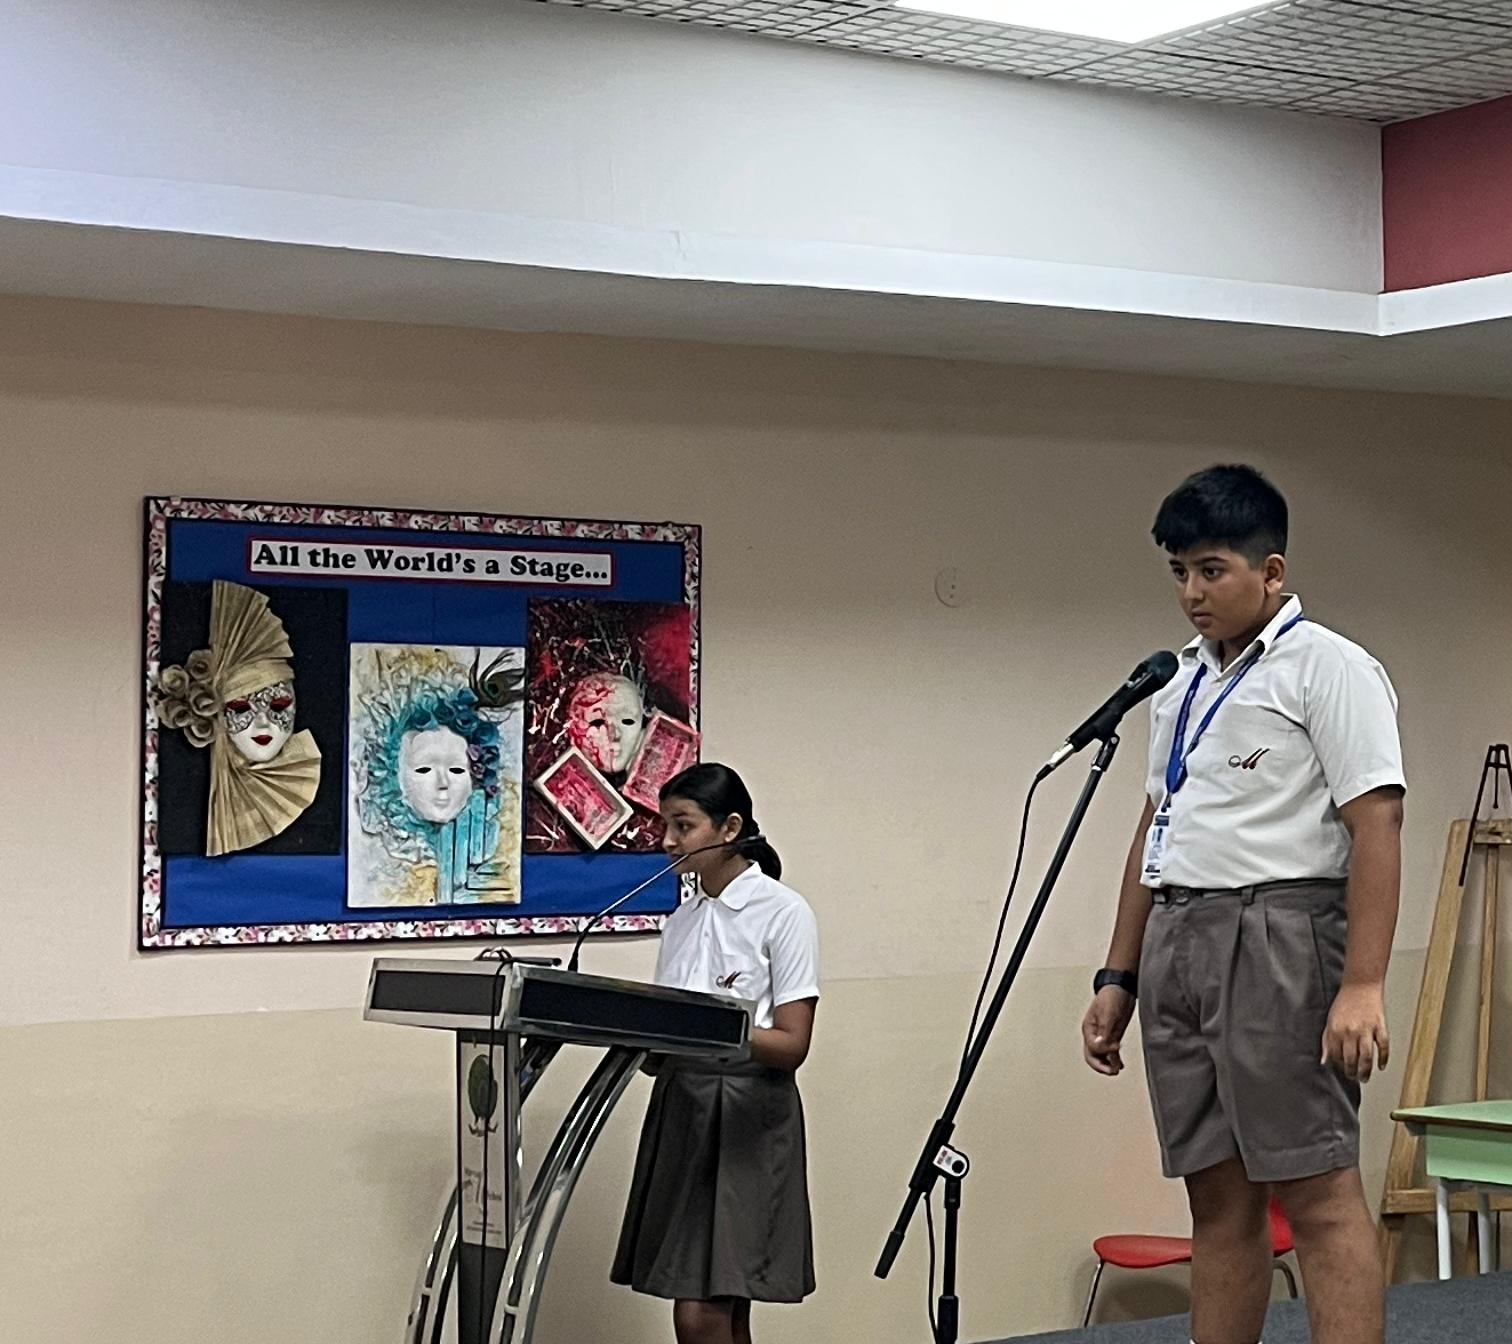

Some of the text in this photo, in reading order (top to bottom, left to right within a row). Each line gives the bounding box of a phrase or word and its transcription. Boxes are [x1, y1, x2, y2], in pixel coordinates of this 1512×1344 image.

[253, 543, 608, 582] All the World's a Stage...
